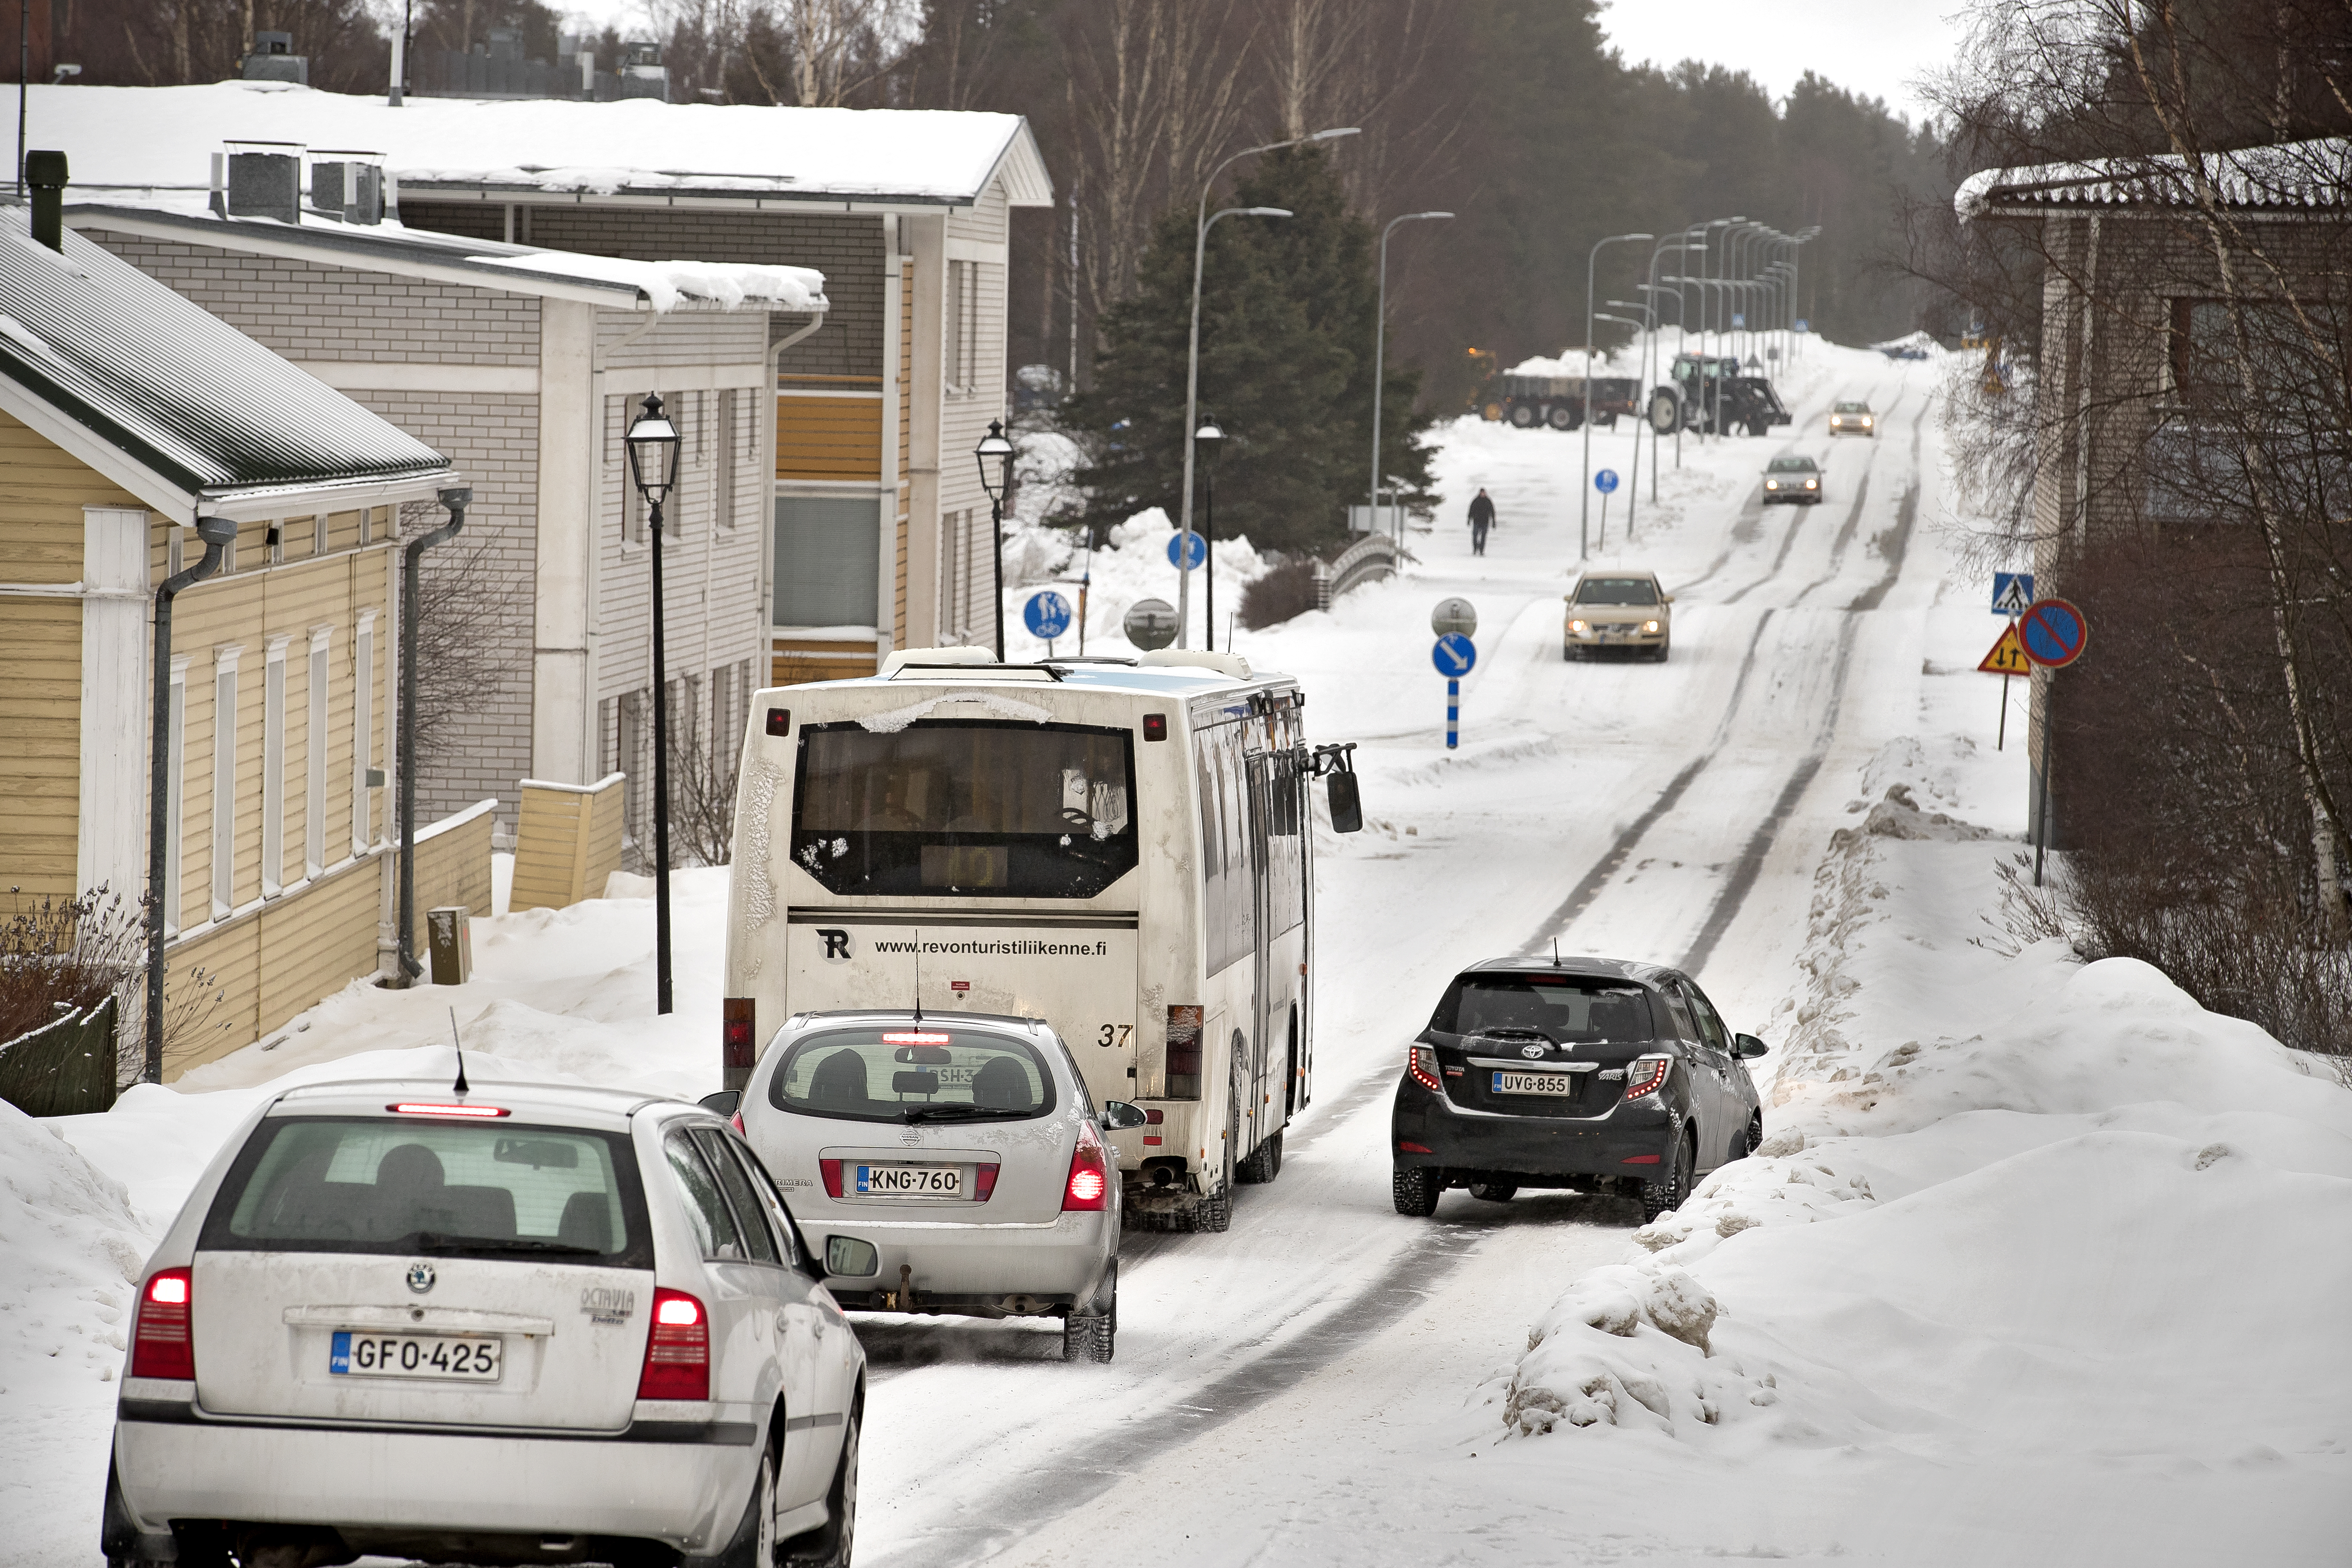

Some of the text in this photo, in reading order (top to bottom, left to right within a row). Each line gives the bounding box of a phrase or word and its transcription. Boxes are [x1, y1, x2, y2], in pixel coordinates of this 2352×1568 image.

[875, 940, 1106, 956] www.revonturistiliikenne.fi
[1098, 1024, 1133, 1047] 37
[930, 1069, 974, 1082] SH-3
[1505, 1076, 1565, 1092] UVG-855
[1599, 1070, 1624, 1080] YARIS
[873, 1170, 956, 1190] KNG-760
[581, 1288, 634, 1310] OCTAVIA
[357, 1339, 492, 1373] GFO-425
